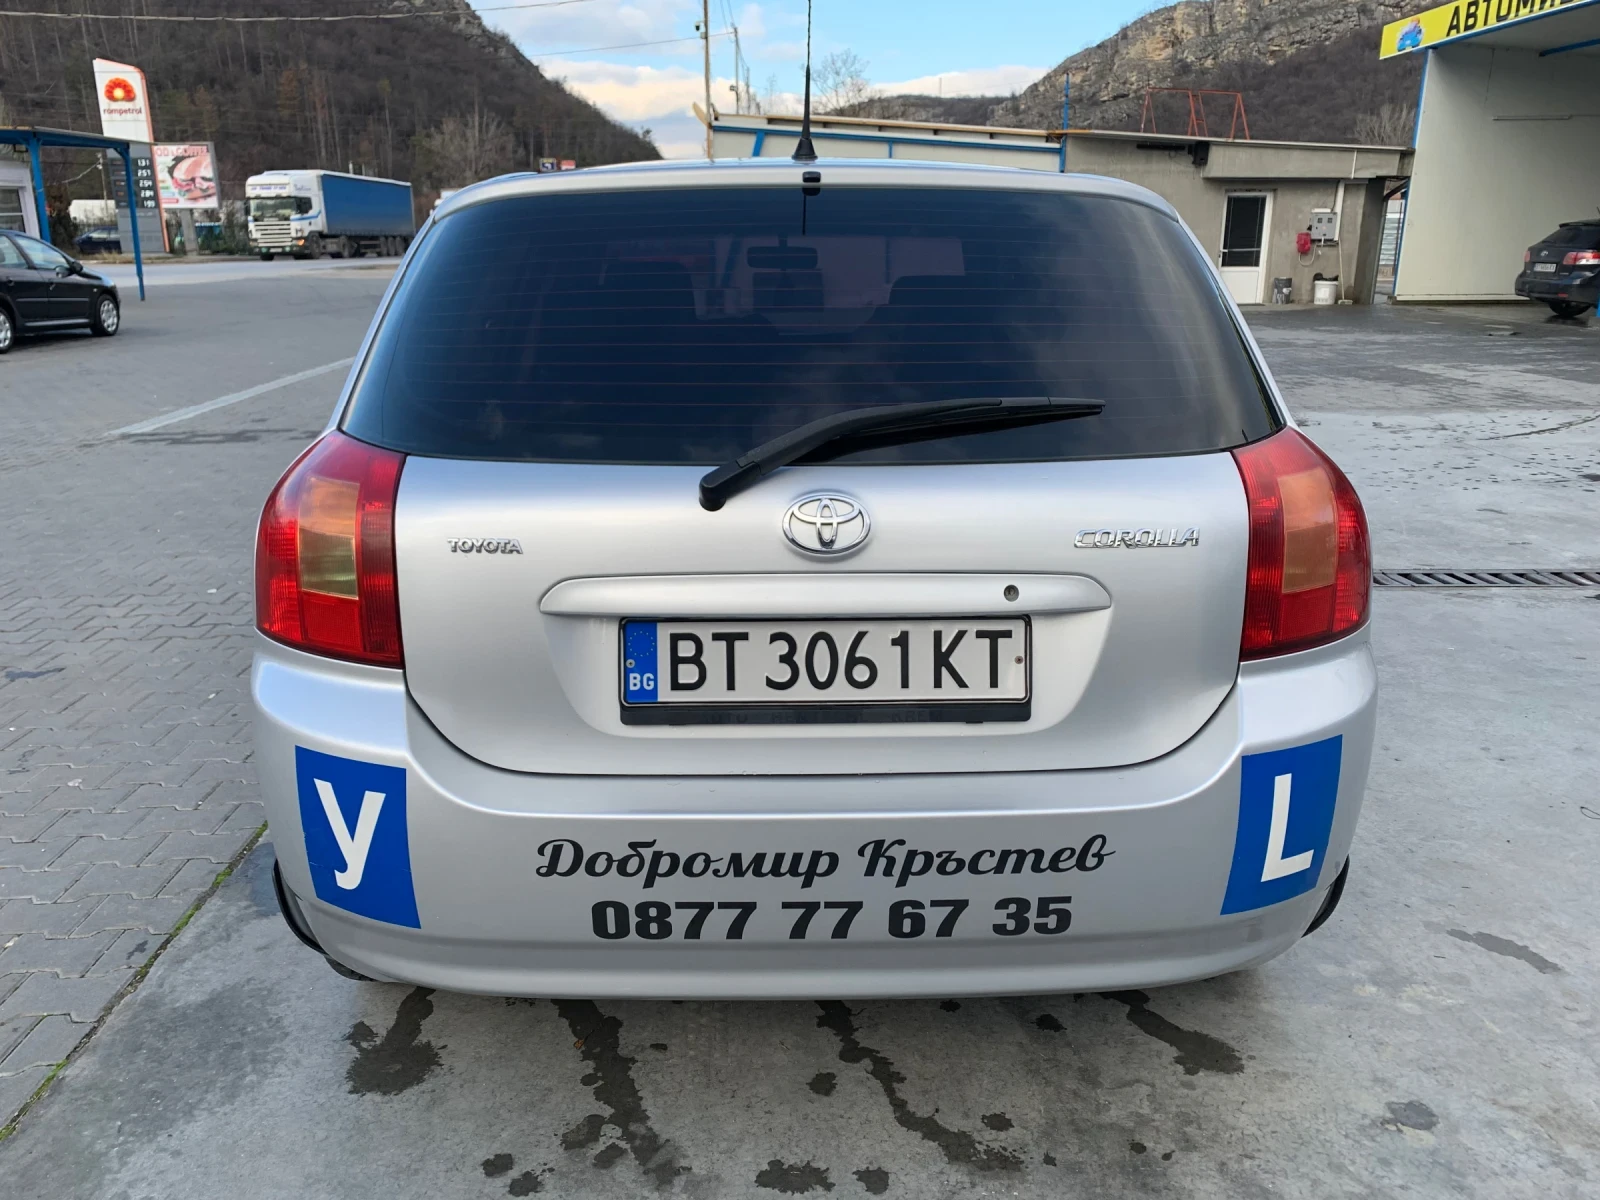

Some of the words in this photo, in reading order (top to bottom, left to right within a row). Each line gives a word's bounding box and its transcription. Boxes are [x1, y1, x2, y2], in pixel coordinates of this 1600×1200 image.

[1446, 0, 1575, 37] АВТОМ
[103, 106, 142, 116] rompetrol
[447, 537, 523, 554] TOYOTA
[1073, 527, 1200, 549] COROLLA
[669, 632, 750, 691] BT
[765, 631, 911, 691] 3061
[933, 629, 1014, 689] KT
[629, 672, 655, 691] BG
[1260, 772, 1315, 883] L
[535, 837, 840, 889] Добромир
[857, 834, 1116, 888] Кръстев
[591, 900, 758, 941] 0877
[781, 900, 864, 940] 77
[888, 898, 970, 939] 67
[992, 895, 1073, 937] 35
